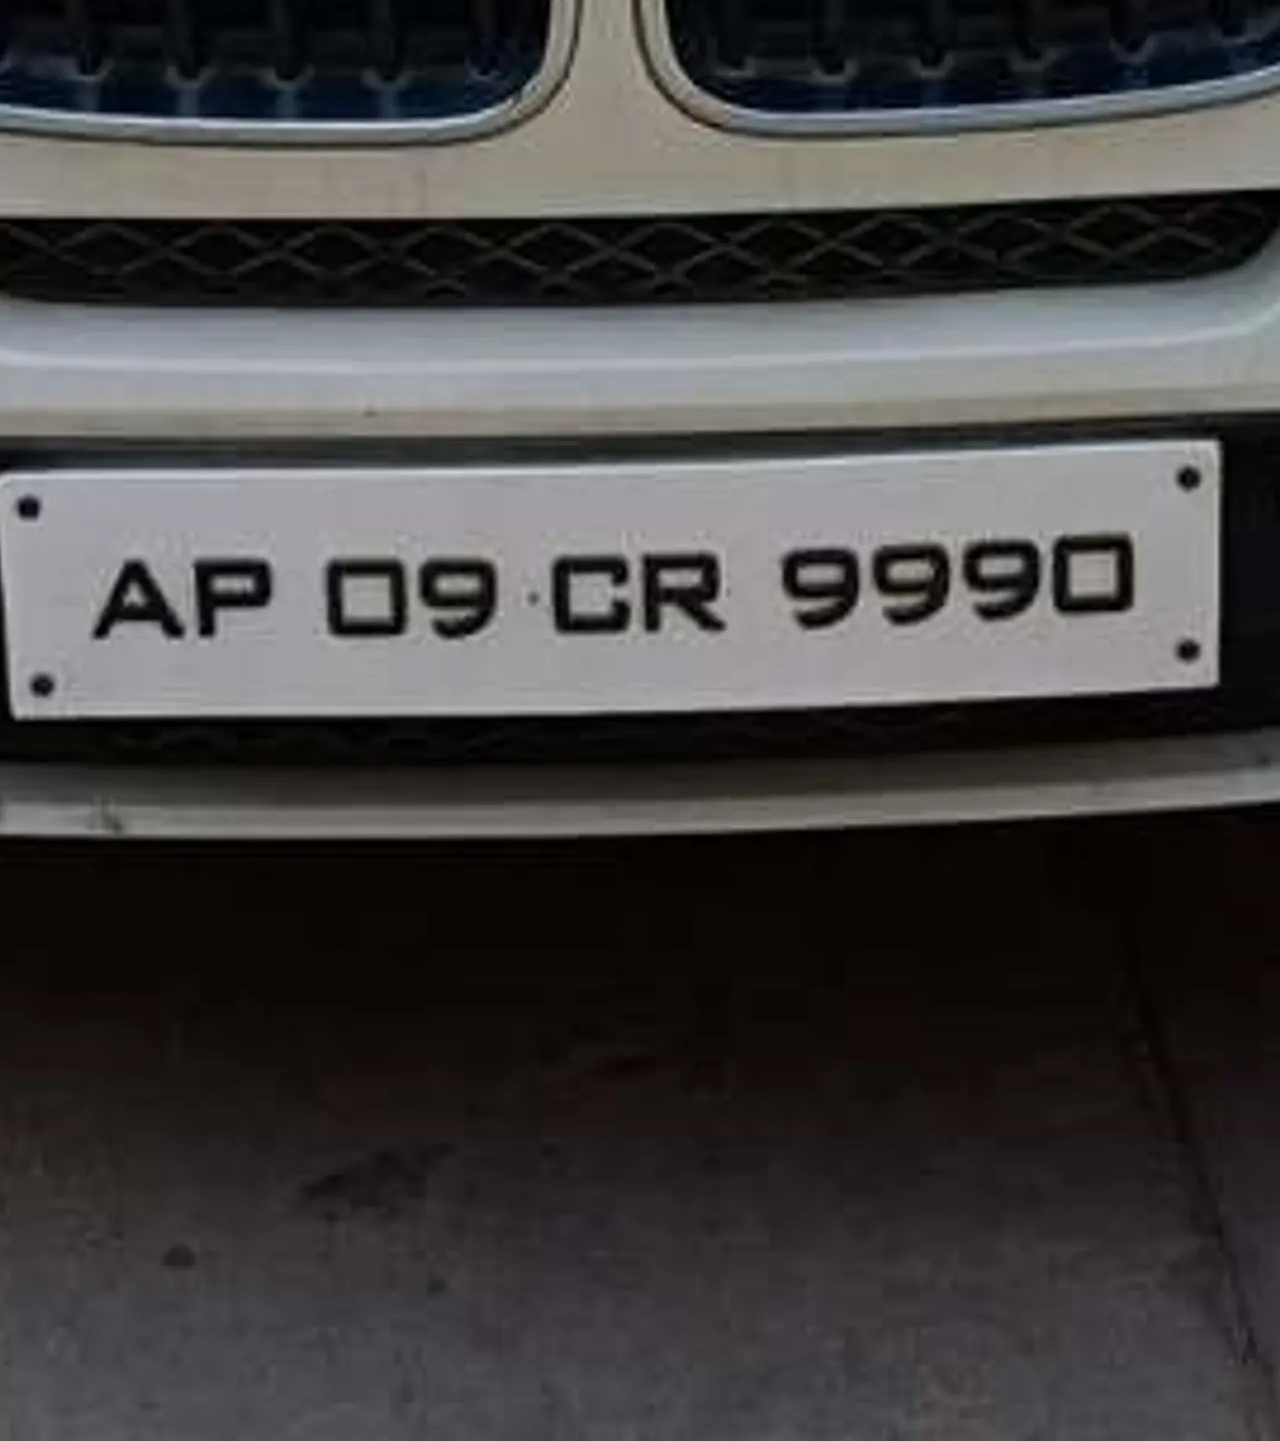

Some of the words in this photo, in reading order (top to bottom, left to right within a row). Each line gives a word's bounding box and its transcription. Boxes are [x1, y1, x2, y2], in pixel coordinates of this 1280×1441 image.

[90, 557, 275, 642] AP
[323, 556, 500, 641] 09
[549, 550, 728, 637] CR
[779, 531, 1137, 633] 9990
